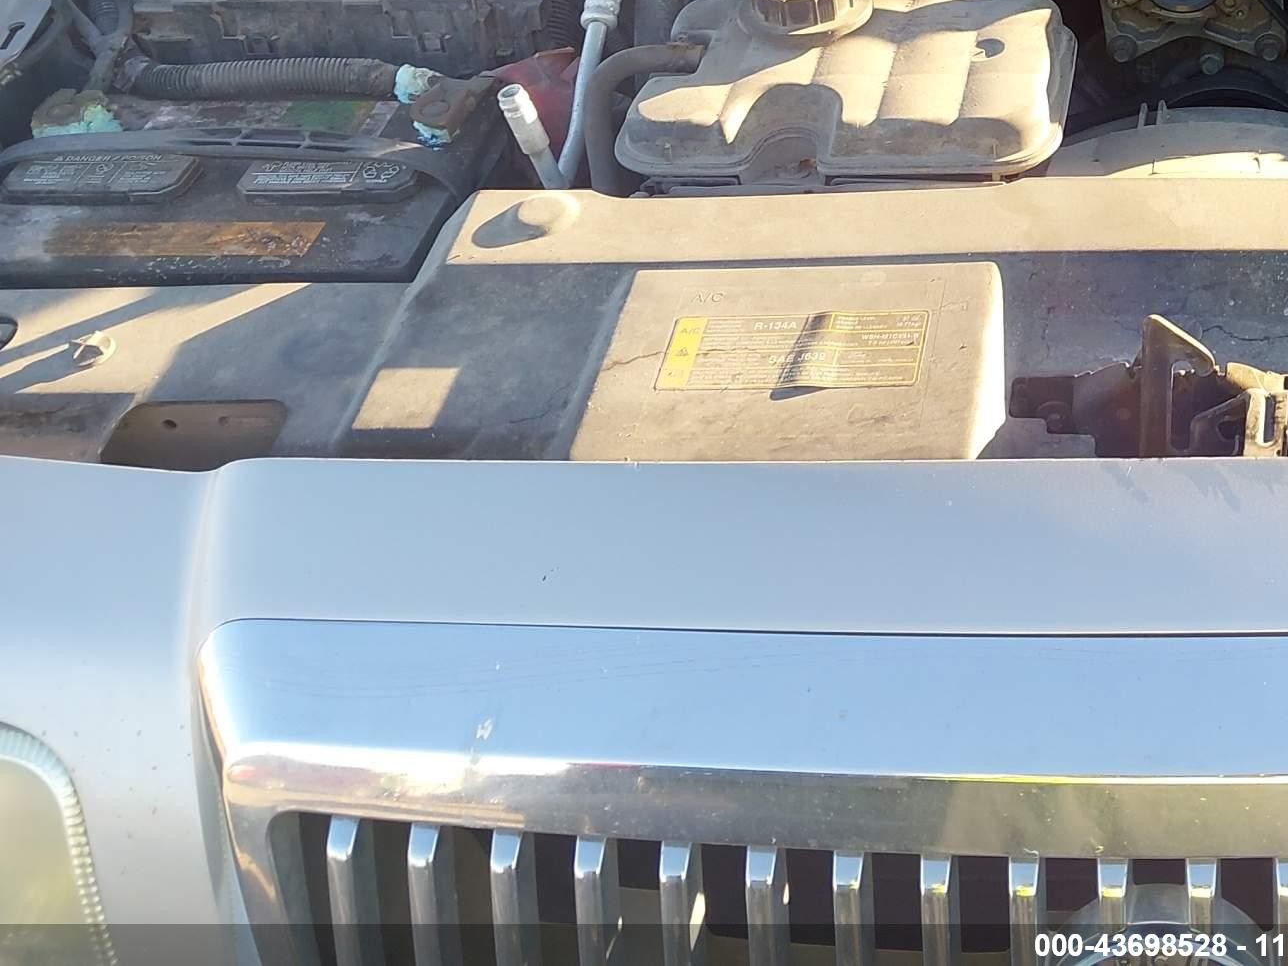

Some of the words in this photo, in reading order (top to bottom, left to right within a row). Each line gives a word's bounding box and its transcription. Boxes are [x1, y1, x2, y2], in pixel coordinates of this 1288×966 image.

[692, 293, 724, 303] A/C
[753, 321, 797, 331] R-134A
[768, 354, 794, 364] SAE
